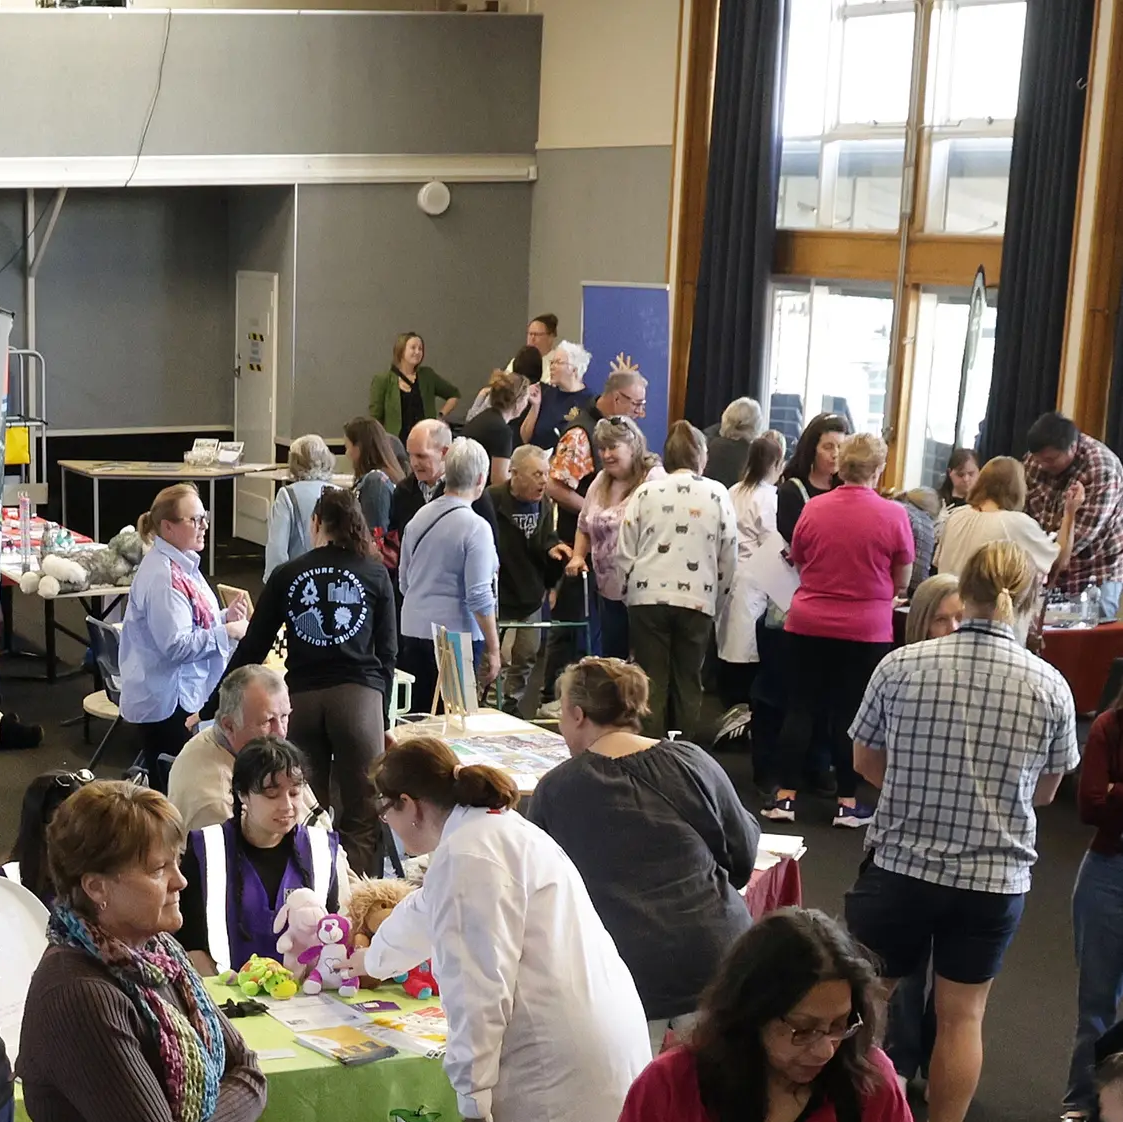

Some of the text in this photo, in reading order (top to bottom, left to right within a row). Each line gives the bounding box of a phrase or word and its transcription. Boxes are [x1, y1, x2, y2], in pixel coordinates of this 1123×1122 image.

[288, 567, 335, 598] ADVENTURE
[343, 569, 367, 599] SOCIAL
[334, 606, 368, 645] EDUCATION
